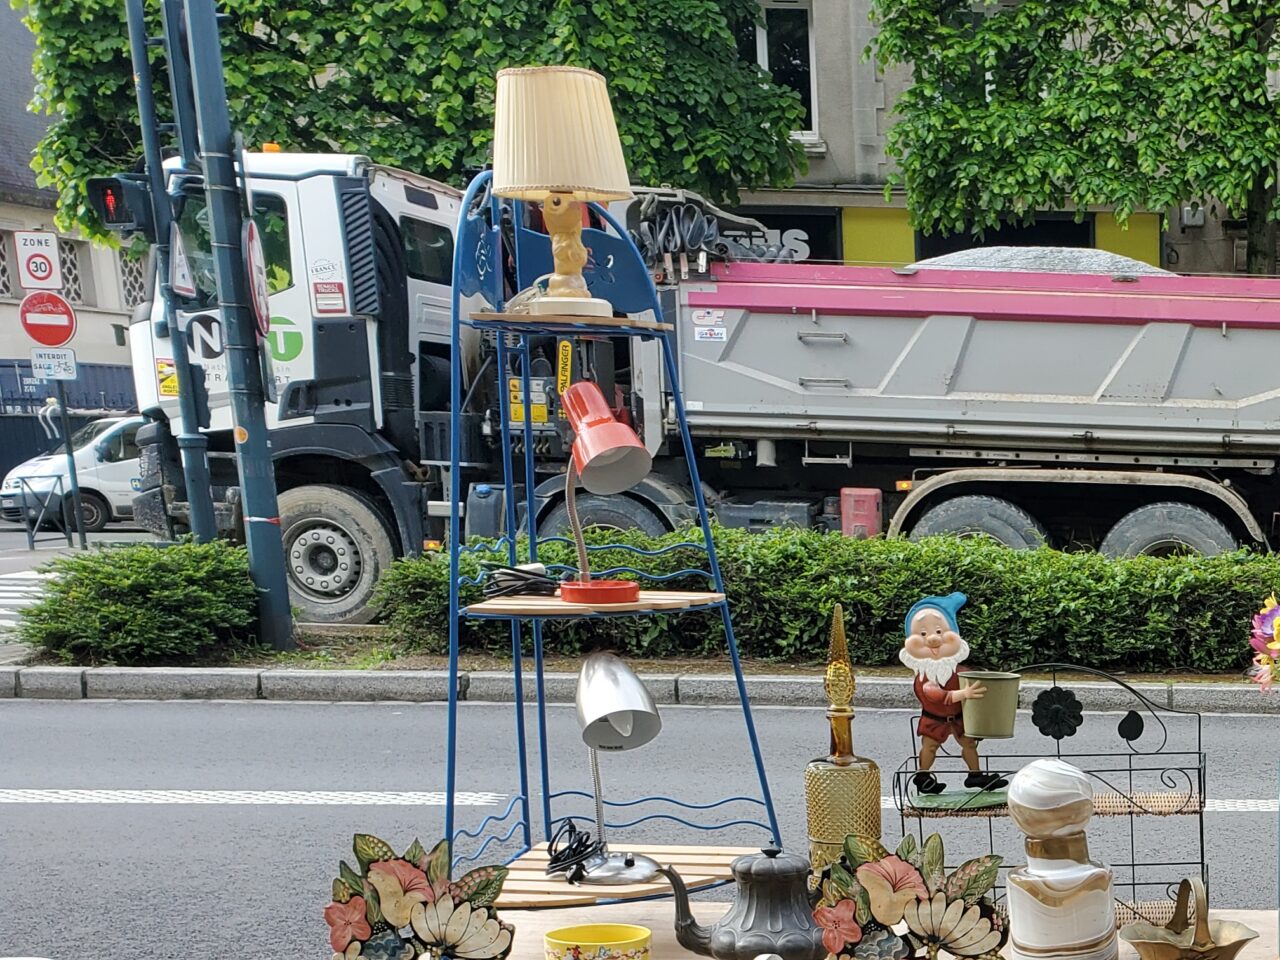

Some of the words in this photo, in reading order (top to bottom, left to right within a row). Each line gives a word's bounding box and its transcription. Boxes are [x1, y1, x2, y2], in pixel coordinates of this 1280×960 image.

[22, 238, 51, 247] ZONE
[31, 261, 48, 273] 30
[560, 344, 570, 393] PALFINGER
